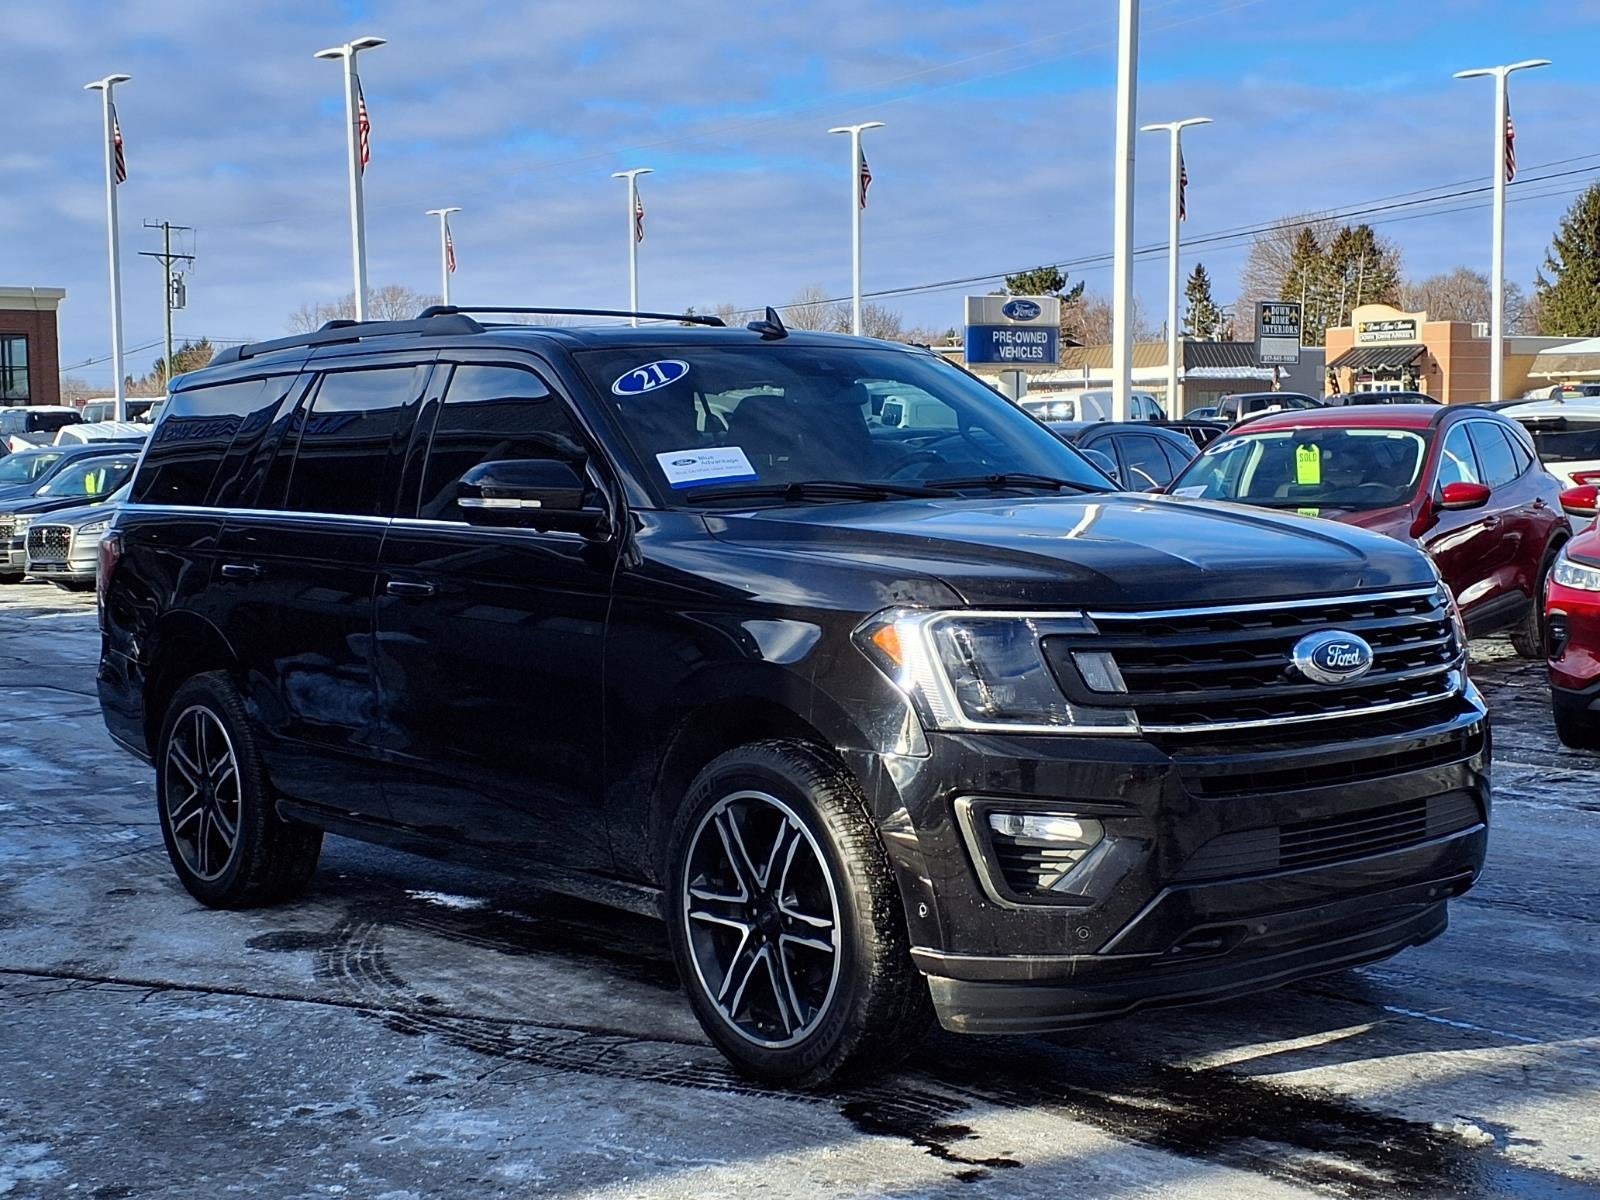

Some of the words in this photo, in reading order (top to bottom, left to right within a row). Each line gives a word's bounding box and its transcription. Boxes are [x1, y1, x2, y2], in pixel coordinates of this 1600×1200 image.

[1271, 306, 1290, 315] DOWN
[1271, 315, 1290, 324] HOME
[1262, 325, 1298, 334] INTERIORS
[992, 331, 1048, 343] PRE-OWNED
[999, 346, 1043, 358] VEHICLES
[633, 363, 670, 390] 21
[1299, 452, 1317, 462] SOLD
[1327, 644, 1361, 667] Ford
